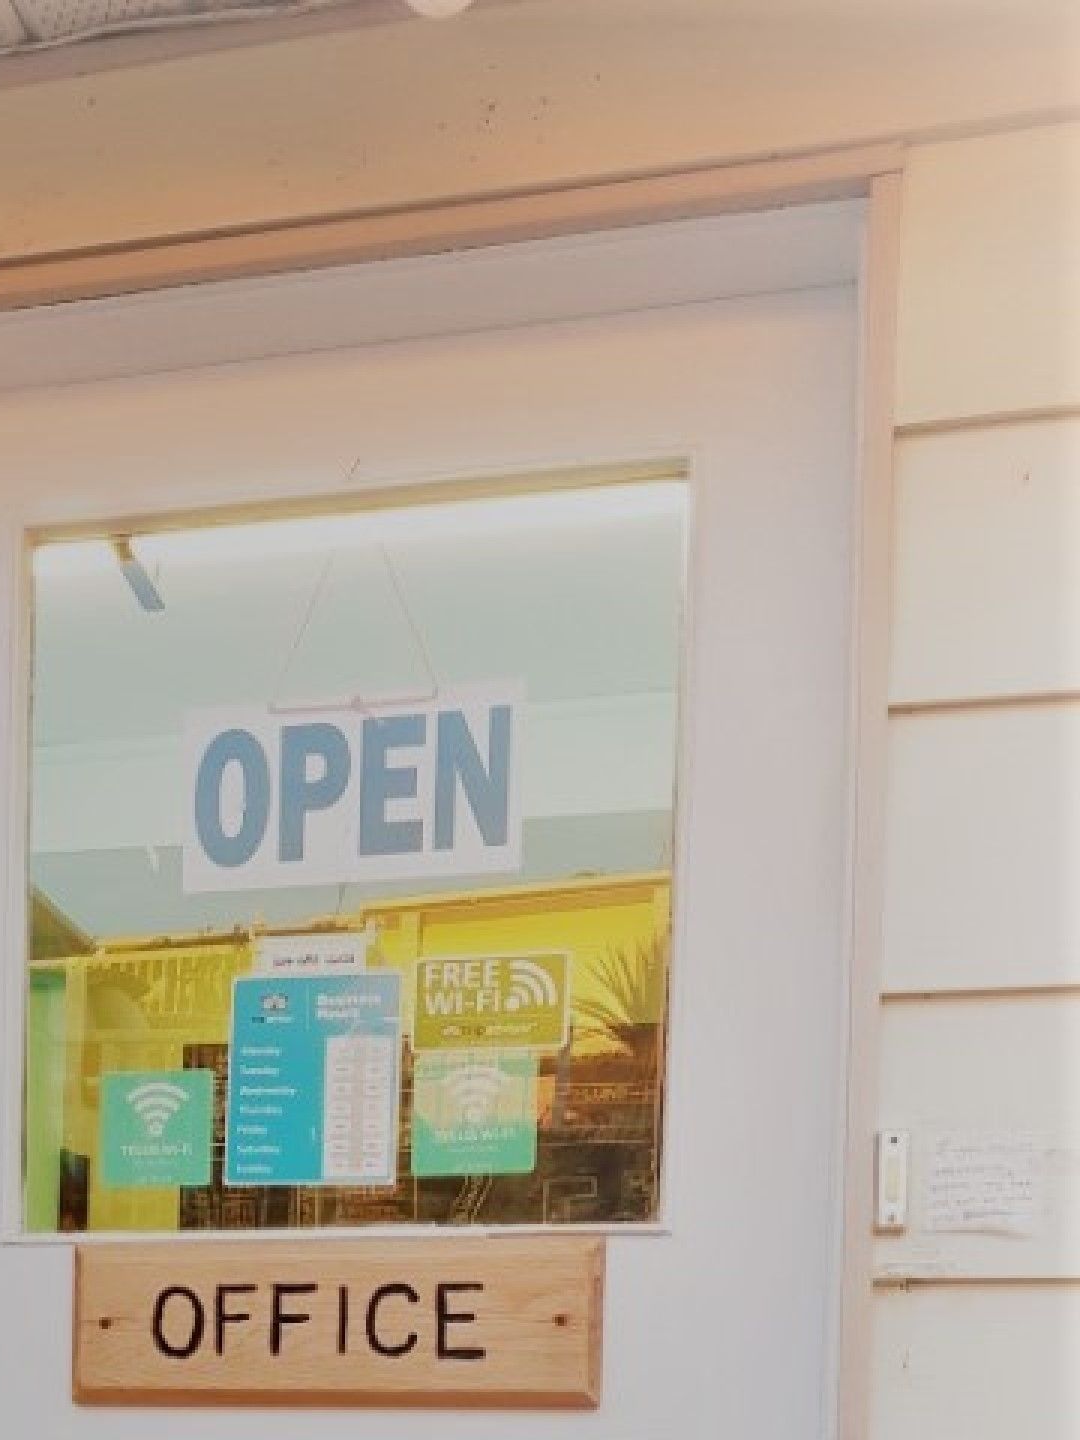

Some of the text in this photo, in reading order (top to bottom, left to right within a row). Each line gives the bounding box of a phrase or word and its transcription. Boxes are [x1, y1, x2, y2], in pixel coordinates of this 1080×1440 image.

[194, 704, 511, 868] OPEN
[424, 959, 502, 989] FREE
[424, 988, 502, 1016] WI-FI
[151, 1282, 487, 1360] OFFICE
